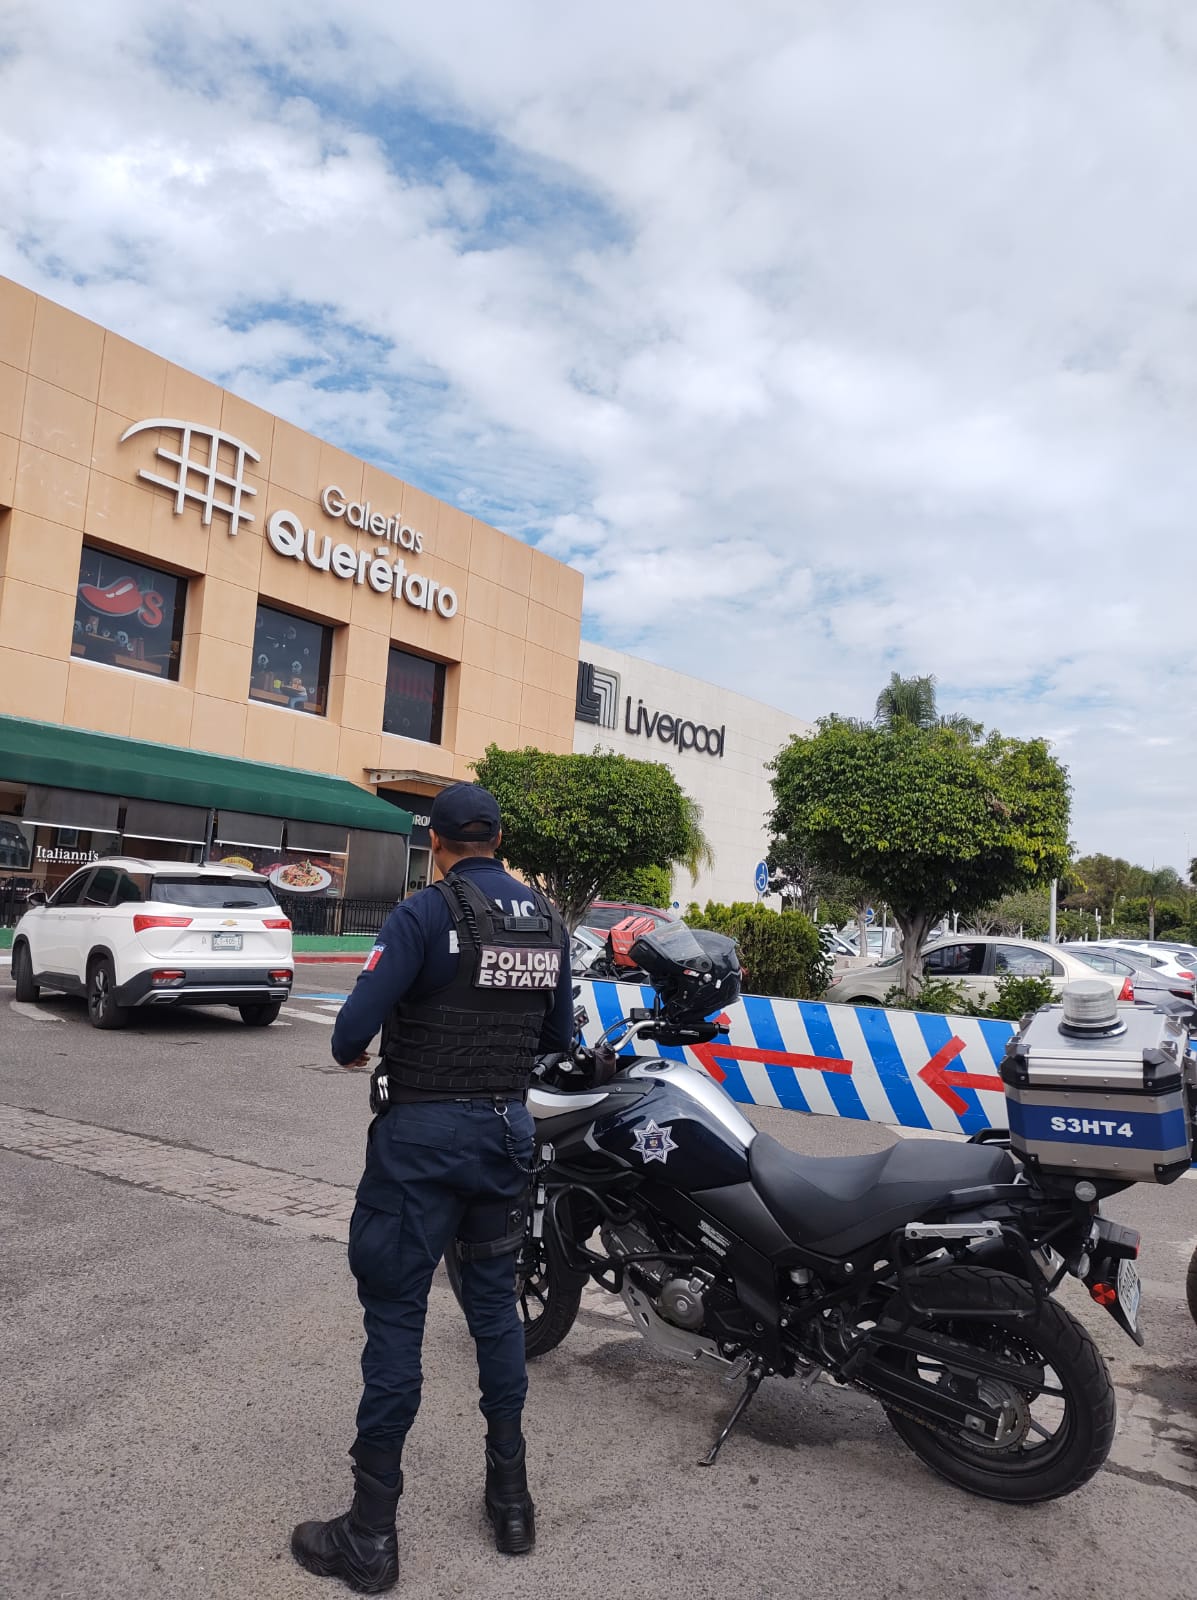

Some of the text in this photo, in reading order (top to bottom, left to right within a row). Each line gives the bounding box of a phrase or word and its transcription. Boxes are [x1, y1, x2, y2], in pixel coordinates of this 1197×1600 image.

[266, 509, 458, 619] Querétaro
[625, 696, 725, 758] Liverpool
[35, 845, 99, 862] Italianni's
[480, 950, 560, 972] POLICÍA
[478, 969, 558, 988] ESTATAL
[1050, 1116, 1134, 1138] S3HT4
